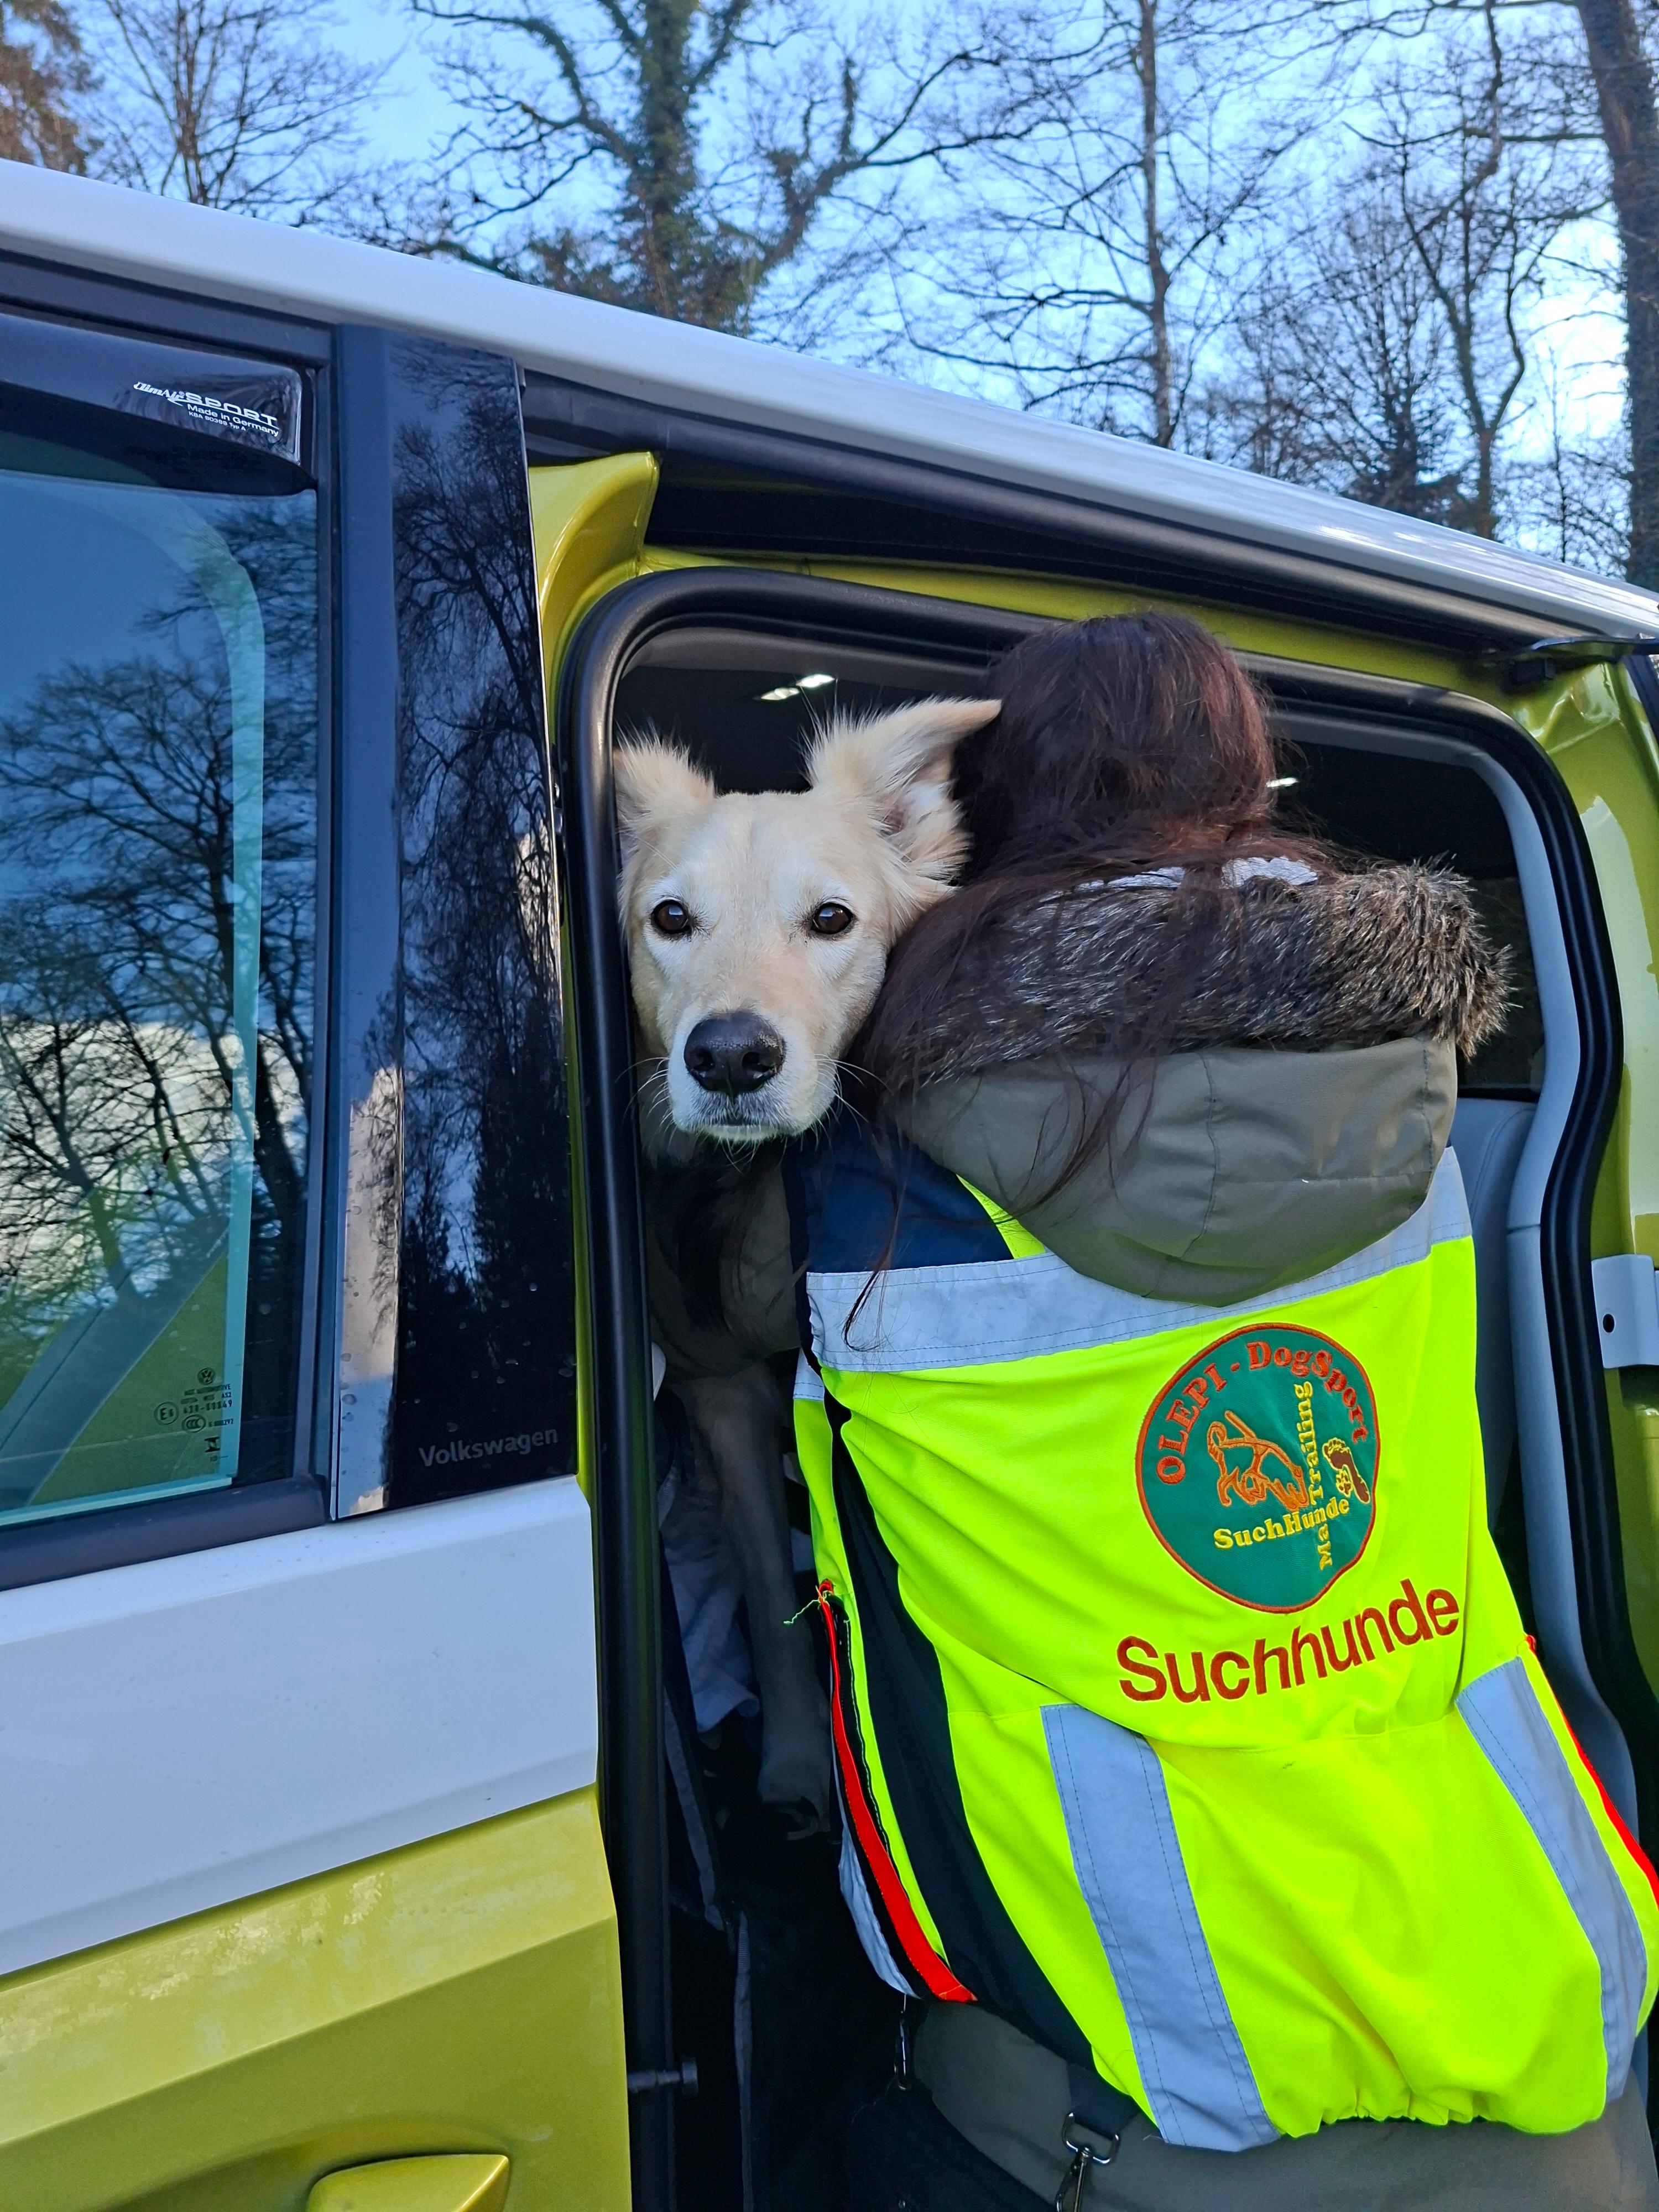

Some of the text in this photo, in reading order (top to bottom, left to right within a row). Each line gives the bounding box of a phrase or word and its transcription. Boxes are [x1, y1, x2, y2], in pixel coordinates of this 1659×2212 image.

[185, 392, 278, 426] SPORT
[187, 404, 218, 417] Made
[232, 416, 279, 437] Germany
[1156, 1363, 1228, 1484] OLEPI
[1246, 1340, 1369, 1444] DogSport
[418, 1429, 559, 1466] Volkswagen
[1213, 1496, 1350, 1550] SuchHunde
[1116, 1579, 1460, 1703] Suchhunde
